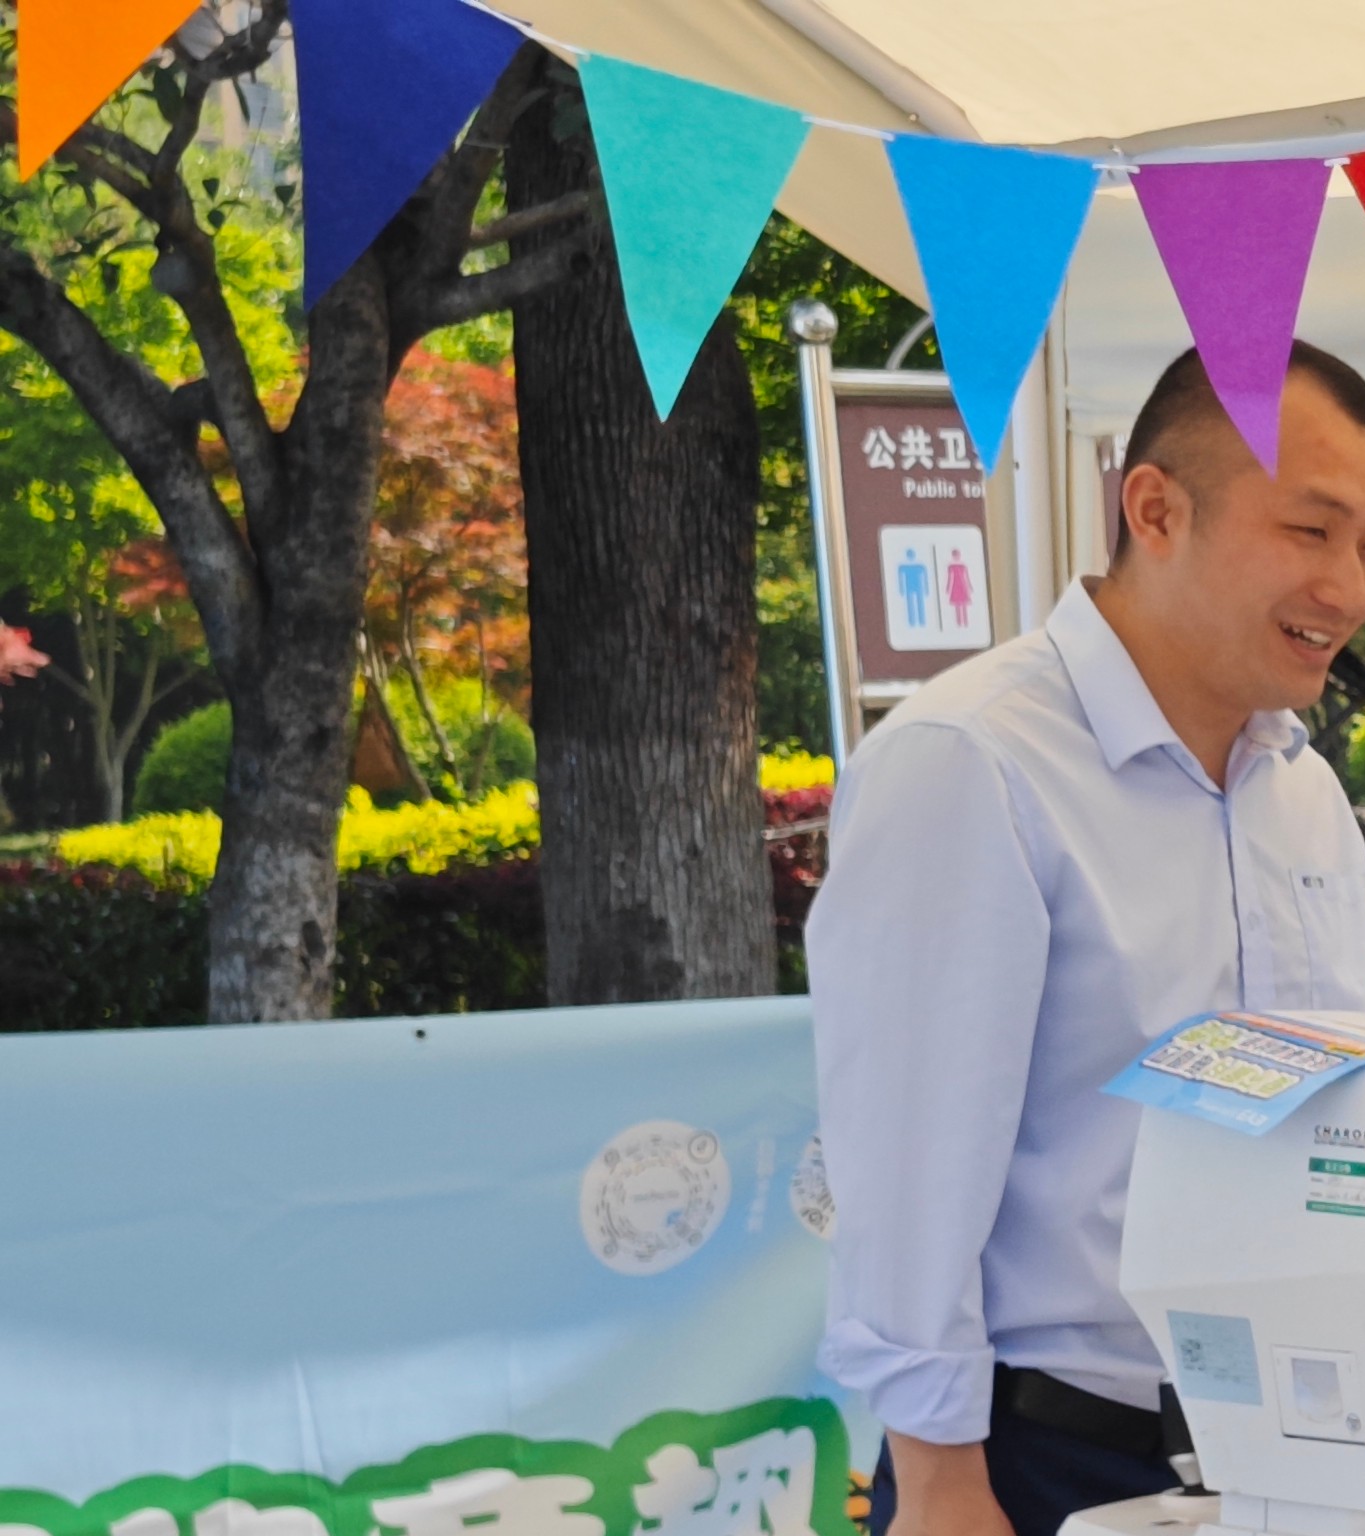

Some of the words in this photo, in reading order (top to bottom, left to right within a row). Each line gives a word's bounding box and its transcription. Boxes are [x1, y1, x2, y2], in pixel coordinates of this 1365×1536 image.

[862, 425, 985, 471] 公共卫
[902, 476, 957, 499] Public
